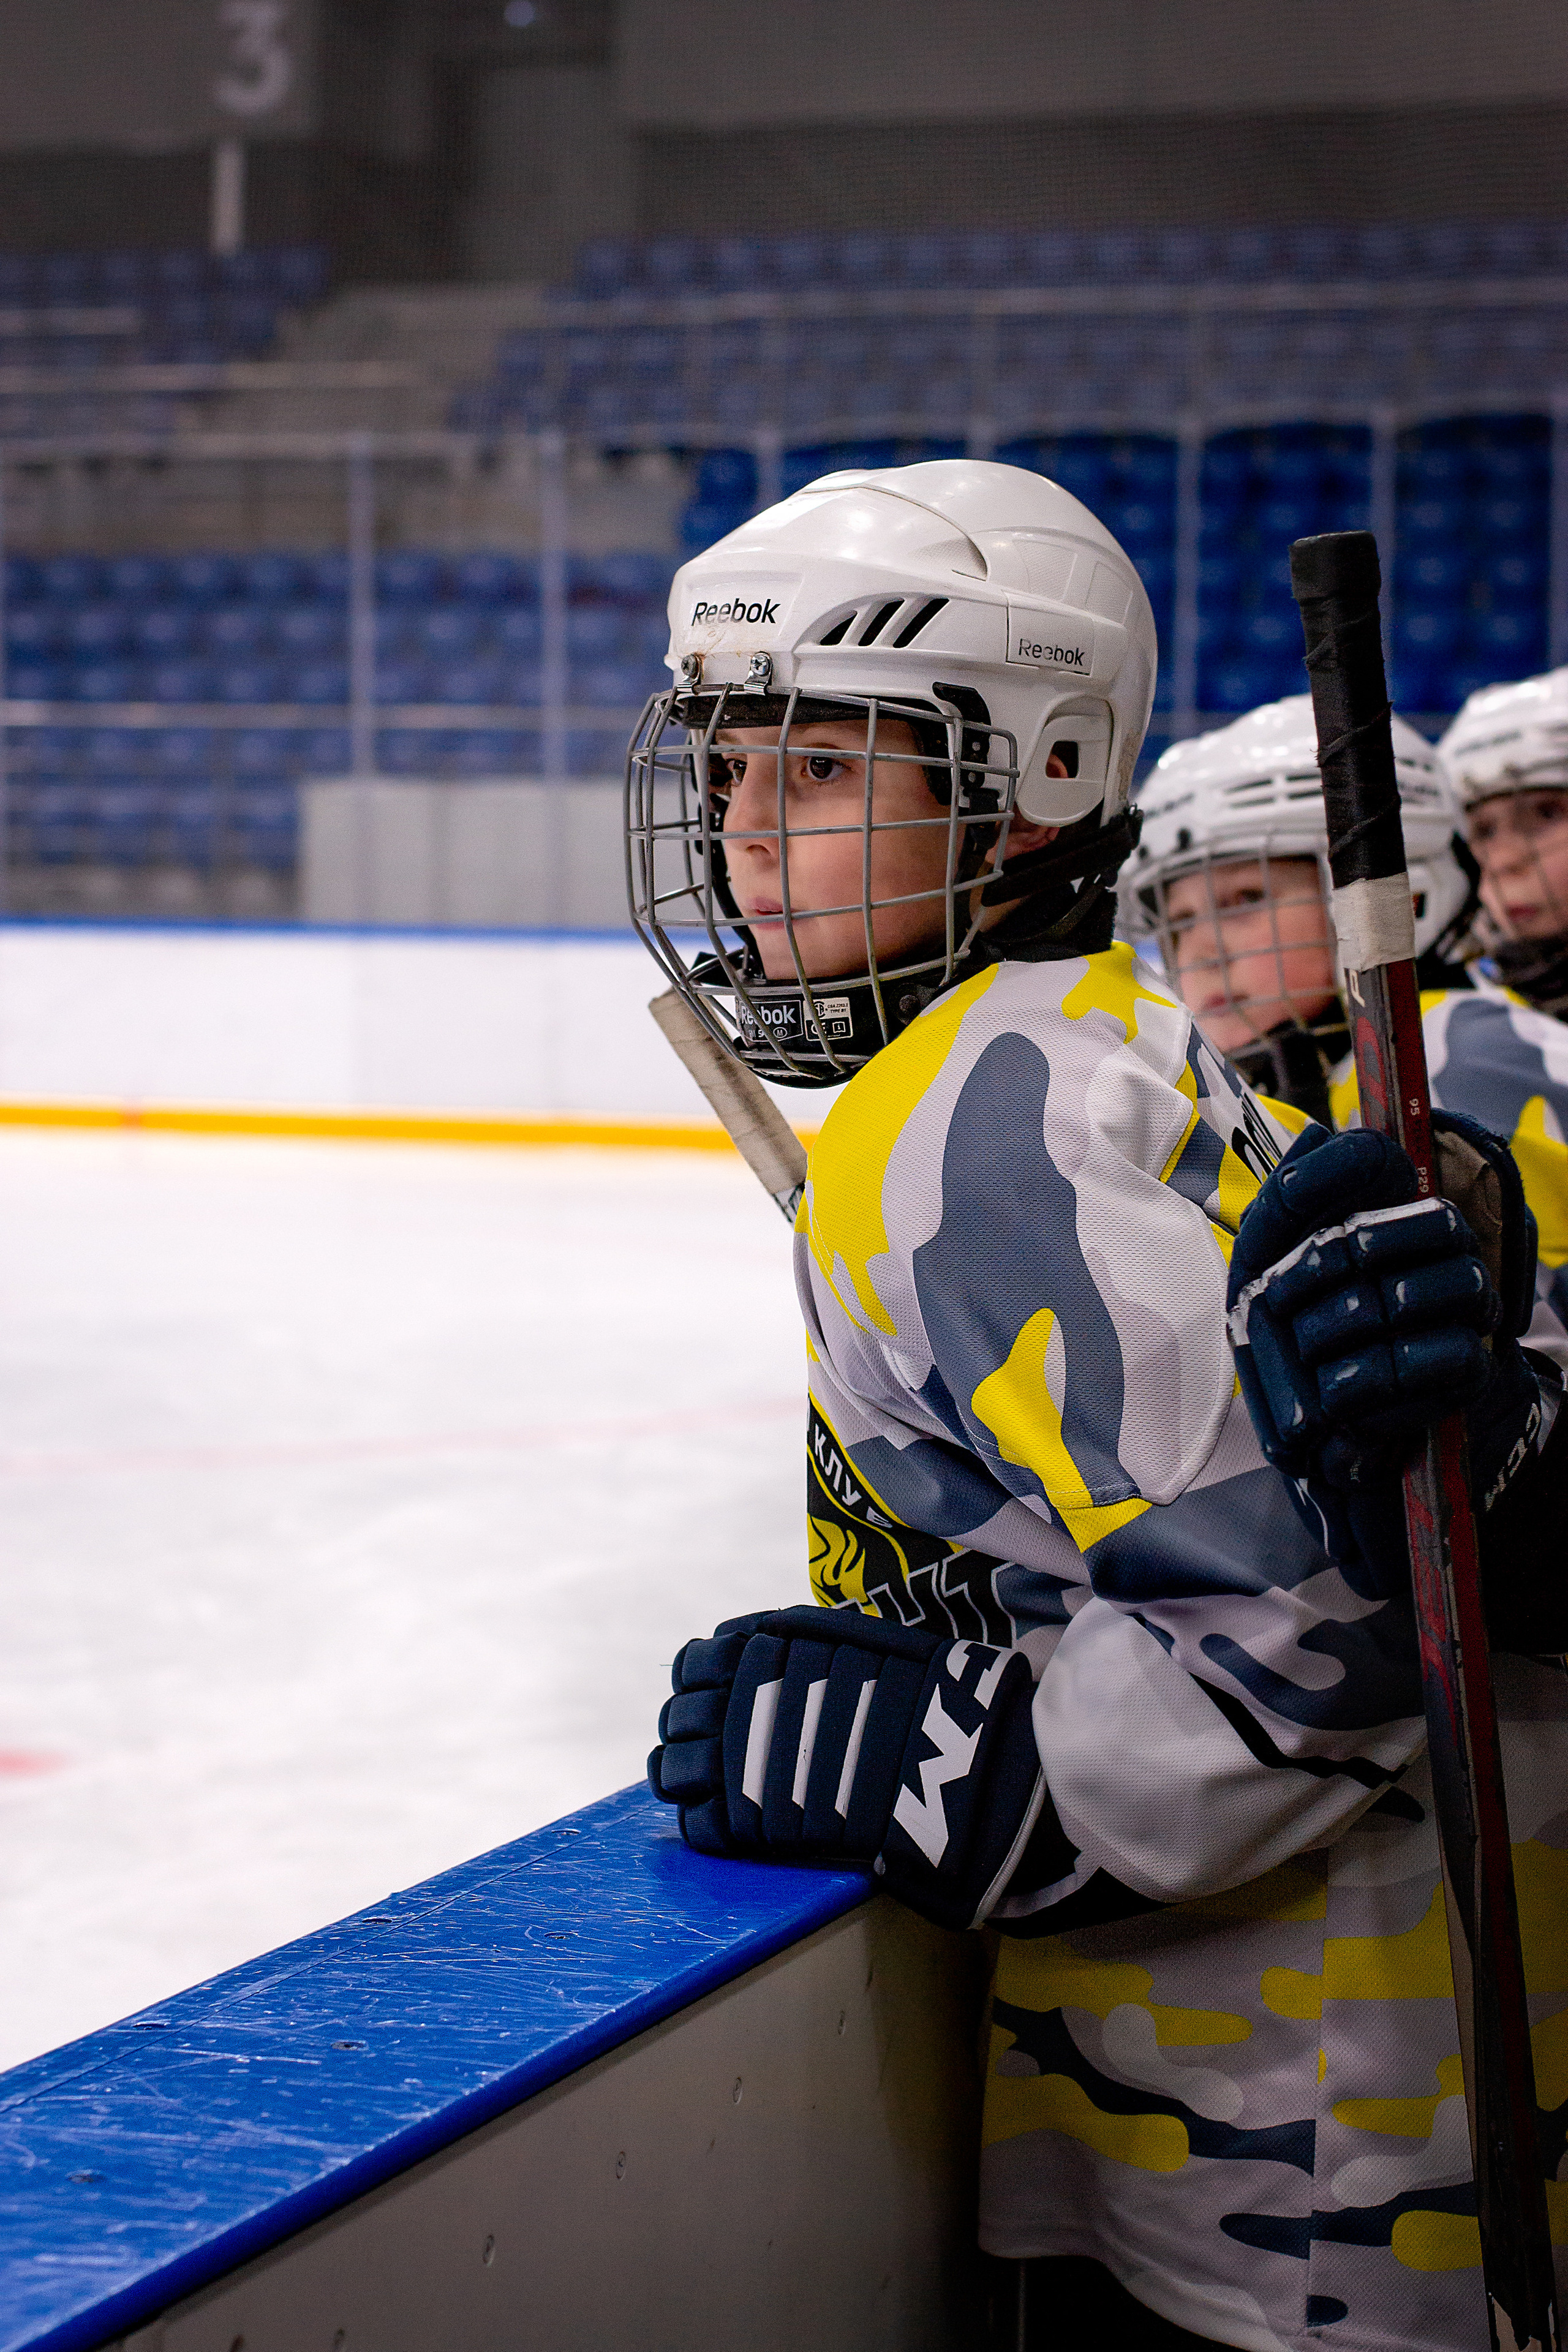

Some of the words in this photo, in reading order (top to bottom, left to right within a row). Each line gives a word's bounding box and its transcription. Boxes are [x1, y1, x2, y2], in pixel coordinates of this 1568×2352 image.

[213, 0, 290, 115] 3
[691, 598, 781, 626] Reebok
[1019, 638, 1085, 666] Reebok
[741, 1005, 796, 1025] Rebok
[1409, 1098, 1420, 1116] 95
[1417, 1166, 1430, 1194] P29
